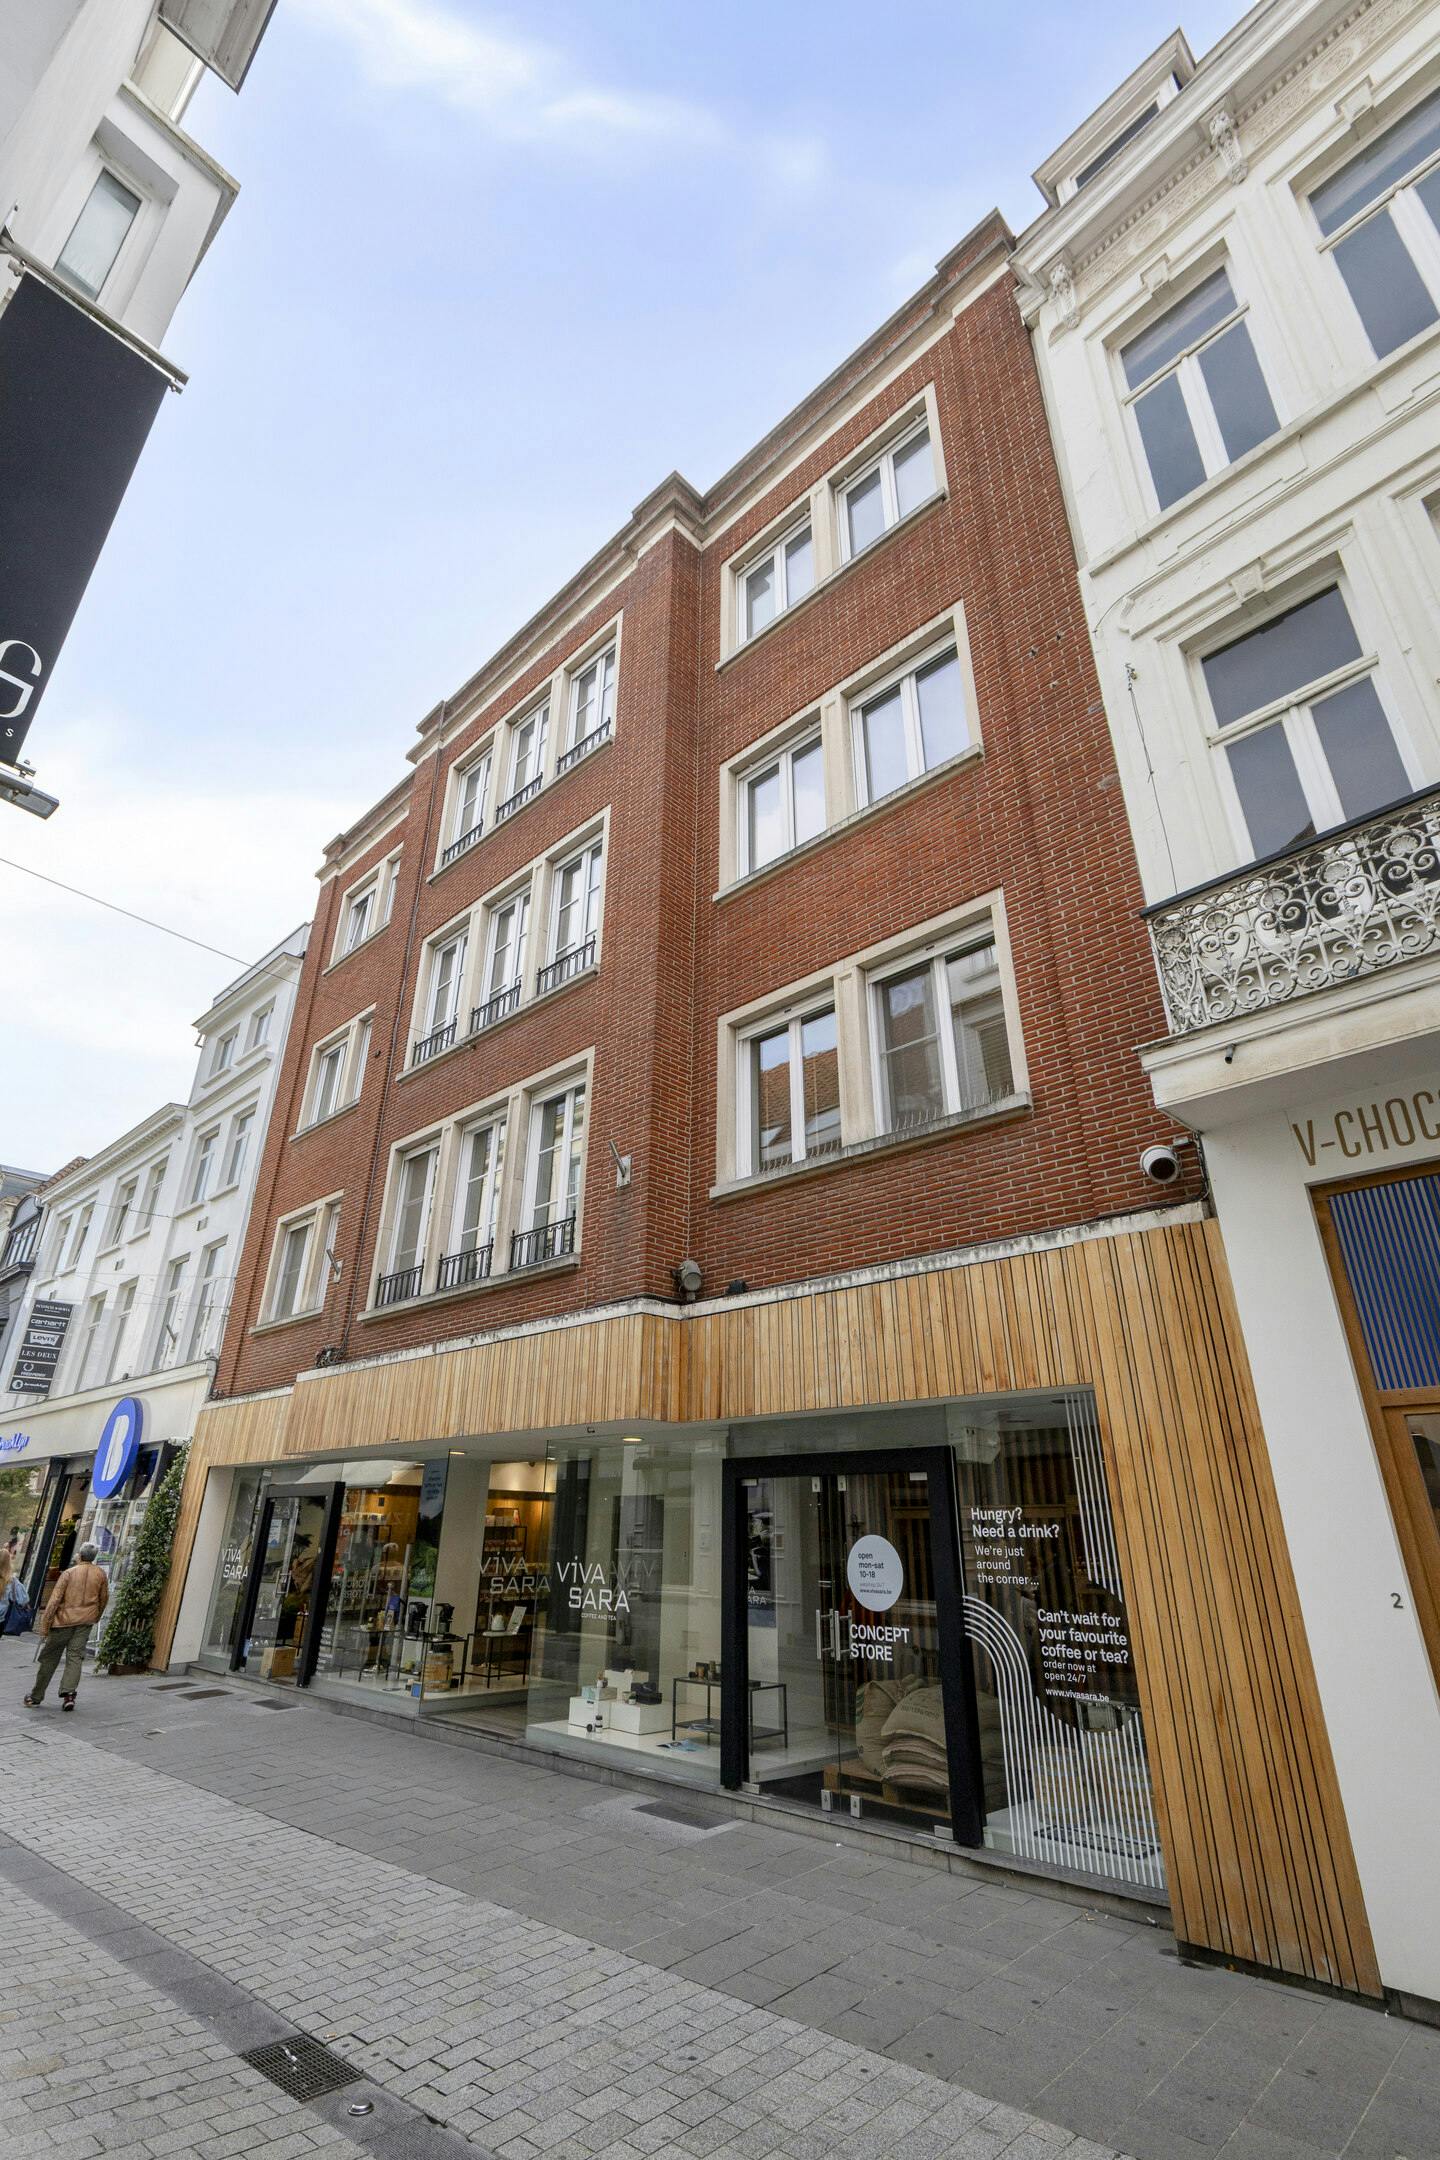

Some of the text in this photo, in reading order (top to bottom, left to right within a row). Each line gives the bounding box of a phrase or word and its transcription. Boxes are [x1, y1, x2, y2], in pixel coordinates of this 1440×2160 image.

[1292, 1089, 1440, 1167] V-CHOC
[21, 1349, 58, 1360] LES DEUX
[971, 1507, 1023, 1524] Hungry?
[972, 1524, 1060, 1539] Need a drink?
[858, 1552, 873, 1560] open
[975, 1545, 1025, 1559] We're just
[223, 1564, 249, 1579] SARA
[976, 1559, 1011, 1571] around
[859, 1570, 876, 1578] 10-18
[977, 1573, 994, 1584] the
[489, 1576, 551, 1594] SARA
[568, 1586, 631, 1613] SARA
[1390, 1592, 1404, 1608] 2
[1037, 1608, 1121, 1628] Can't wait for
[849, 1624, 910, 1644] CONCEPT
[1039, 1627, 1128, 1646] your favourite
[850, 1643, 894, 1662] STORE
[1041, 1643, 1129, 1664] coffee or tea?
[1043, 1659, 1097, 1673] order now at
[1044, 1672, 1087, 1684] open 24/7
[1045, 1687, 1110, 1703] www.vivasara.be
